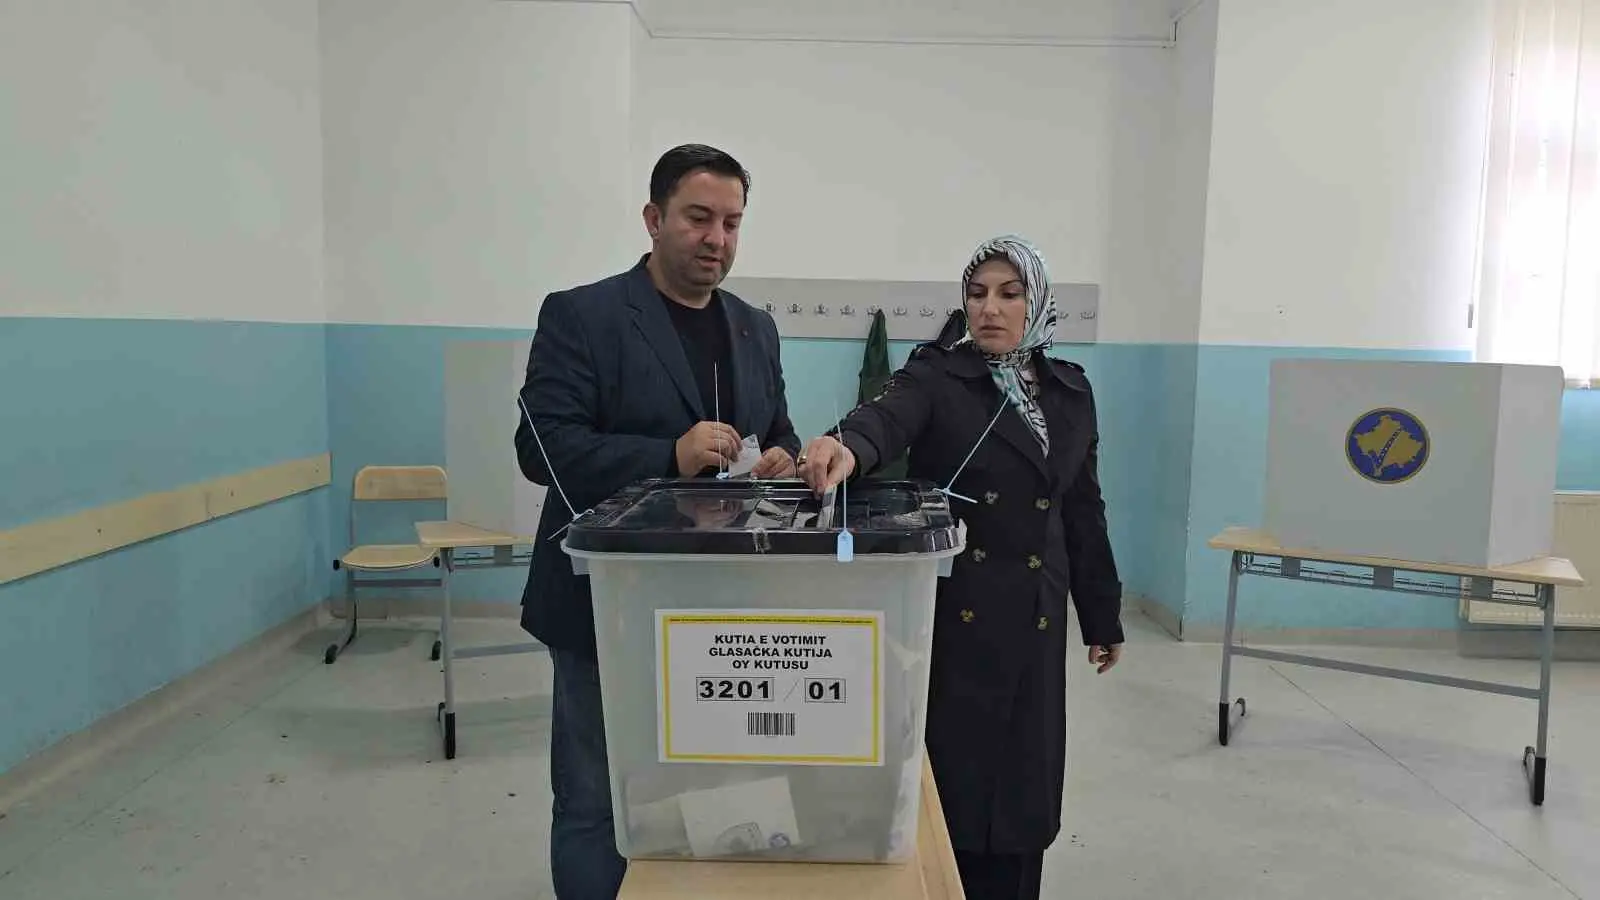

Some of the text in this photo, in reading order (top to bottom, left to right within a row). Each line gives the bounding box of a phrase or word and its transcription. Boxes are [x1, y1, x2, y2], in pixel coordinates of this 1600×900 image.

[714, 634, 827, 646] KUTIA E VOTIMIT
[708, 645, 833, 658] GLASAČKA KUTIJA
[732, 659, 809, 670] OY KUTUSU
[699, 680, 770, 699] 3201
[808, 681, 841, 701] 01
